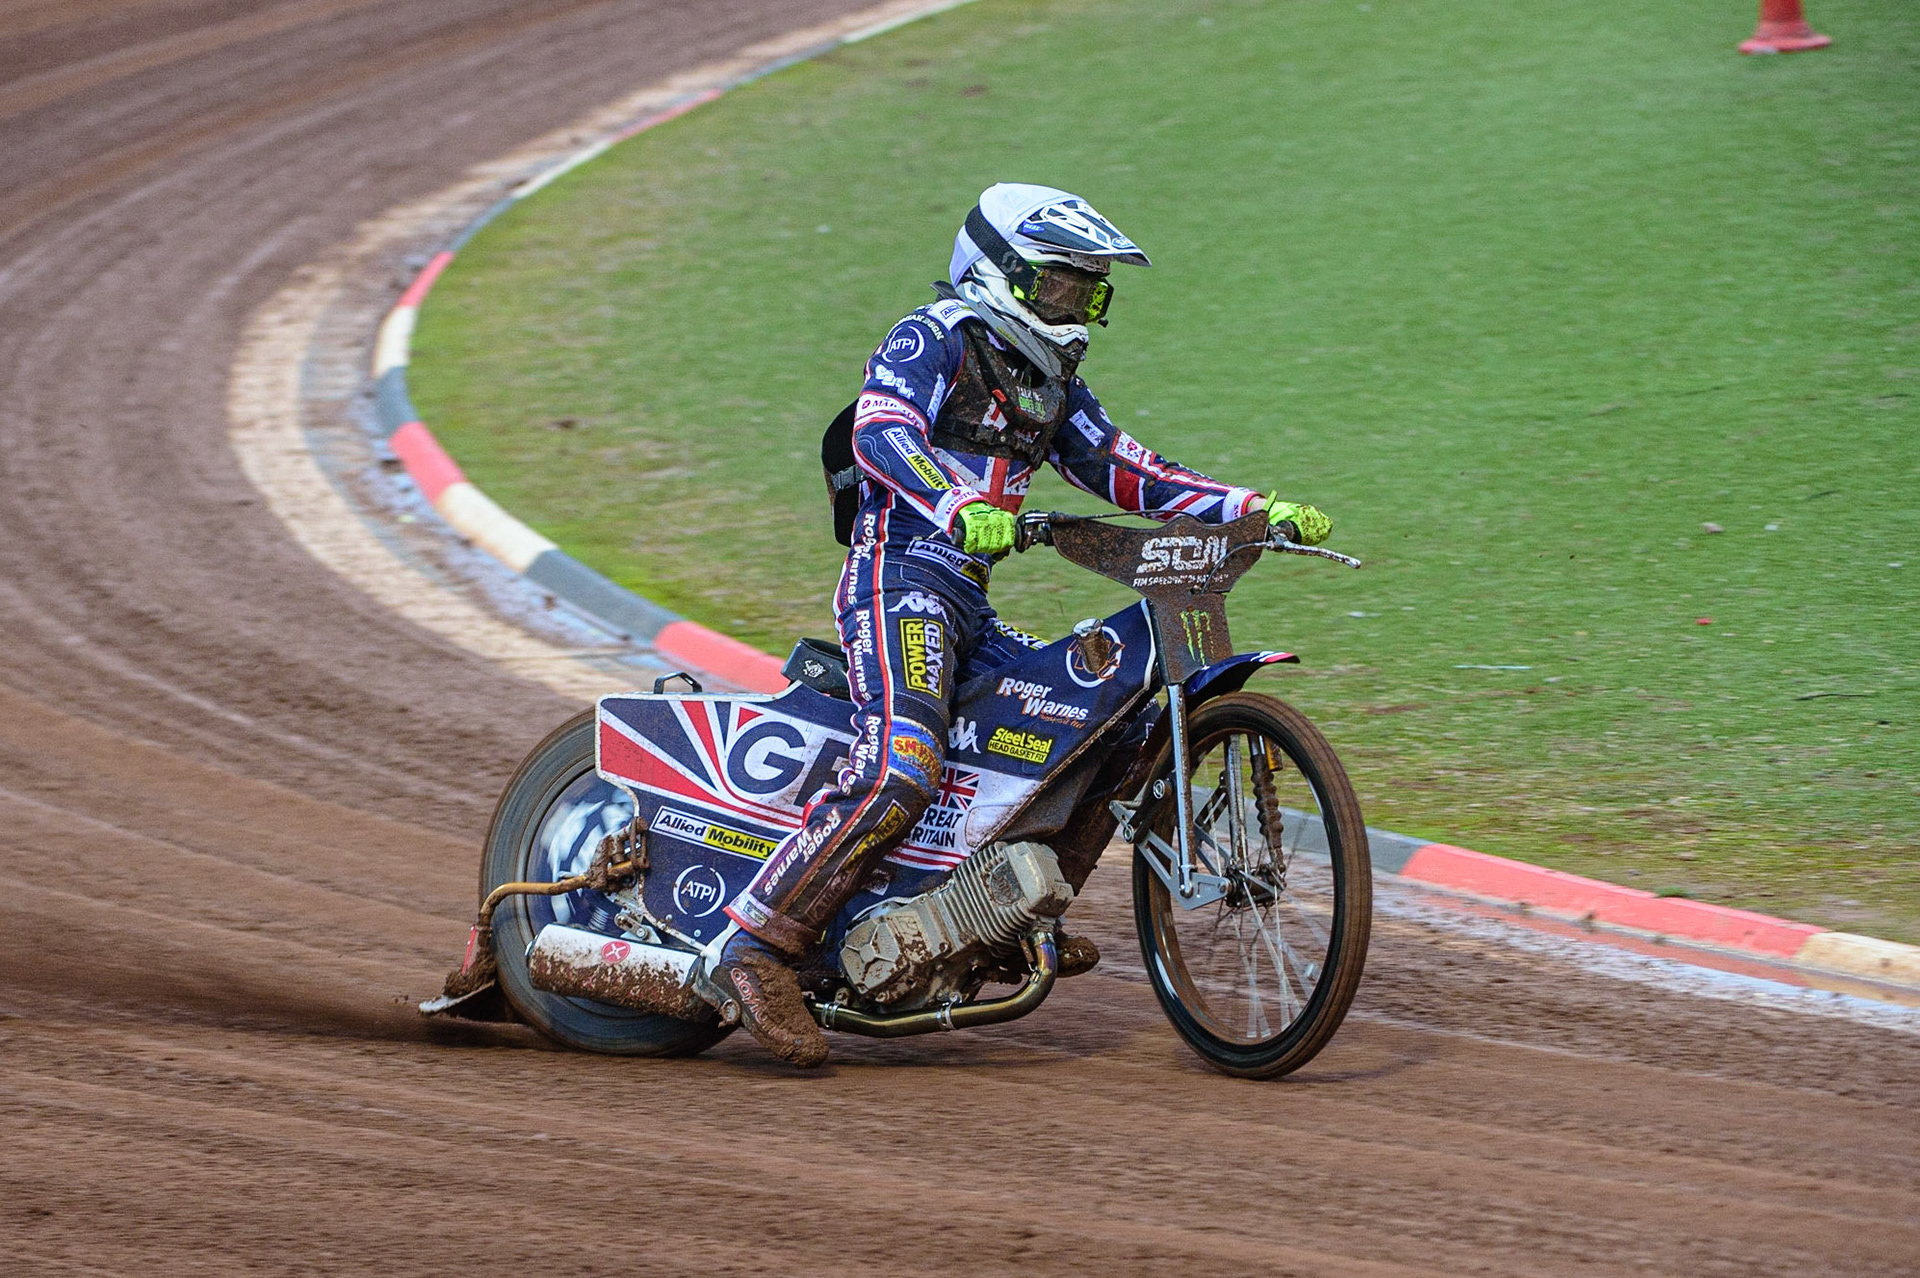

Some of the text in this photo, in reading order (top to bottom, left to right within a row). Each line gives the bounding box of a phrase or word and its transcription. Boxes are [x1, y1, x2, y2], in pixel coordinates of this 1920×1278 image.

[888, 337, 917, 354] ATPI
[890, 430, 917, 455] Allied
[911, 454, 948, 488] Mobilit
[862, 513, 877, 560] Roger
[914, 543, 970, 568] Allied
[848, 545, 865, 605] Warnes
[856, 609, 873, 655] Roger
[852, 639, 873, 702] Warnes
[905, 622, 926, 688] POWER
[924, 622, 944, 694] MAXED
[997, 677, 1053, 700] Roger
[1023, 696, 1089, 720] Warnes
[866, 715, 882, 764] Roger
[989, 741, 1047, 762] HEAD GASKET FIX
[992, 727, 1053, 754] Steel Seal
[841, 744, 871, 796] Wares
[658, 814, 776, 858] Allied Mobility
[803, 808, 843, 864] Roger
[911, 826, 956, 848] RITAIN
[922, 807, 964, 829] REAT
[764, 827, 812, 897] Warnes
[680, 880, 717, 903] ATPI
